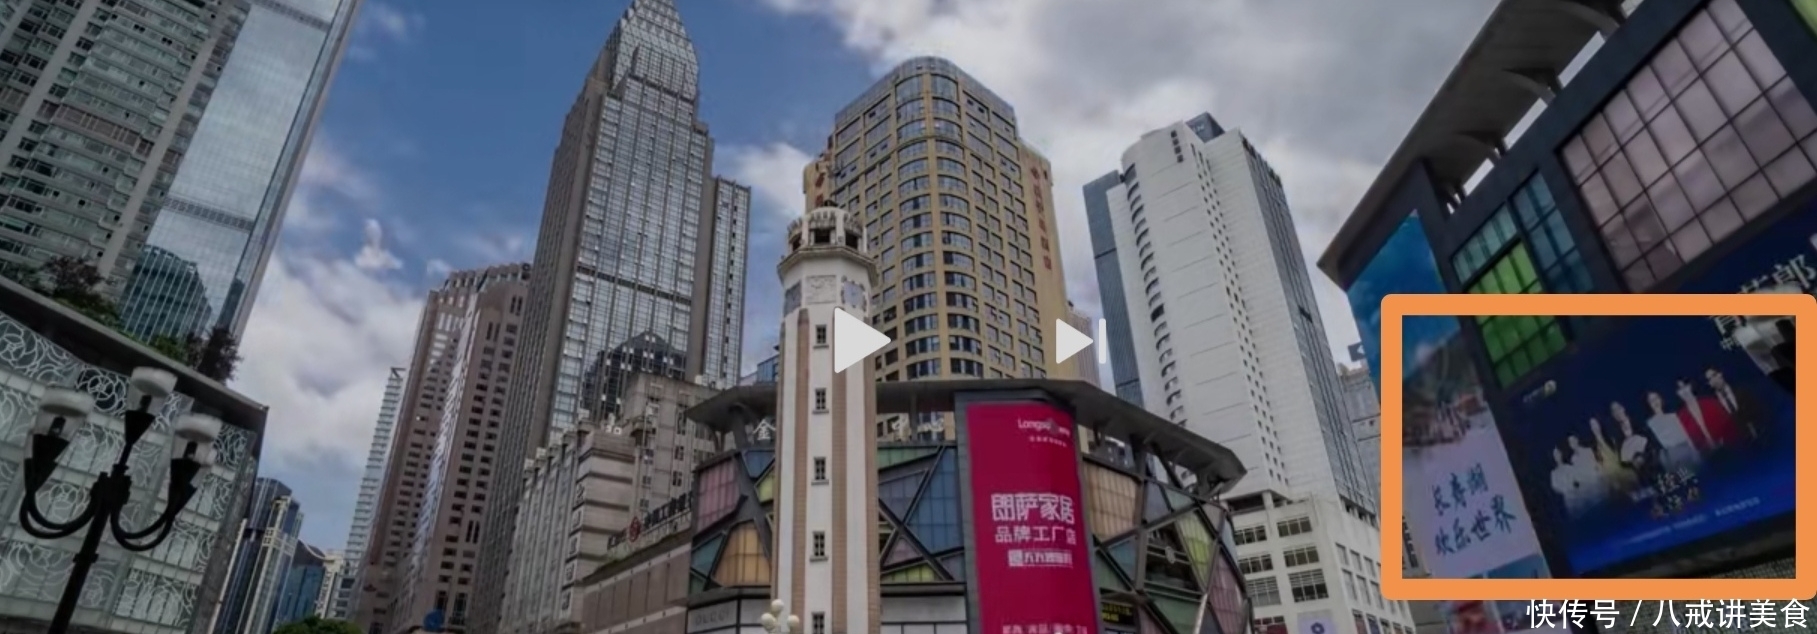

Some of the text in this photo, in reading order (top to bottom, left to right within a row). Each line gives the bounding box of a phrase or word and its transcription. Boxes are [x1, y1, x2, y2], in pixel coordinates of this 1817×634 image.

[1432, 462, 1489, 517] 长寿湖
[995, 526, 1076, 545] 品牌工厂店
[1434, 494, 1517, 556] 欢乐世界
